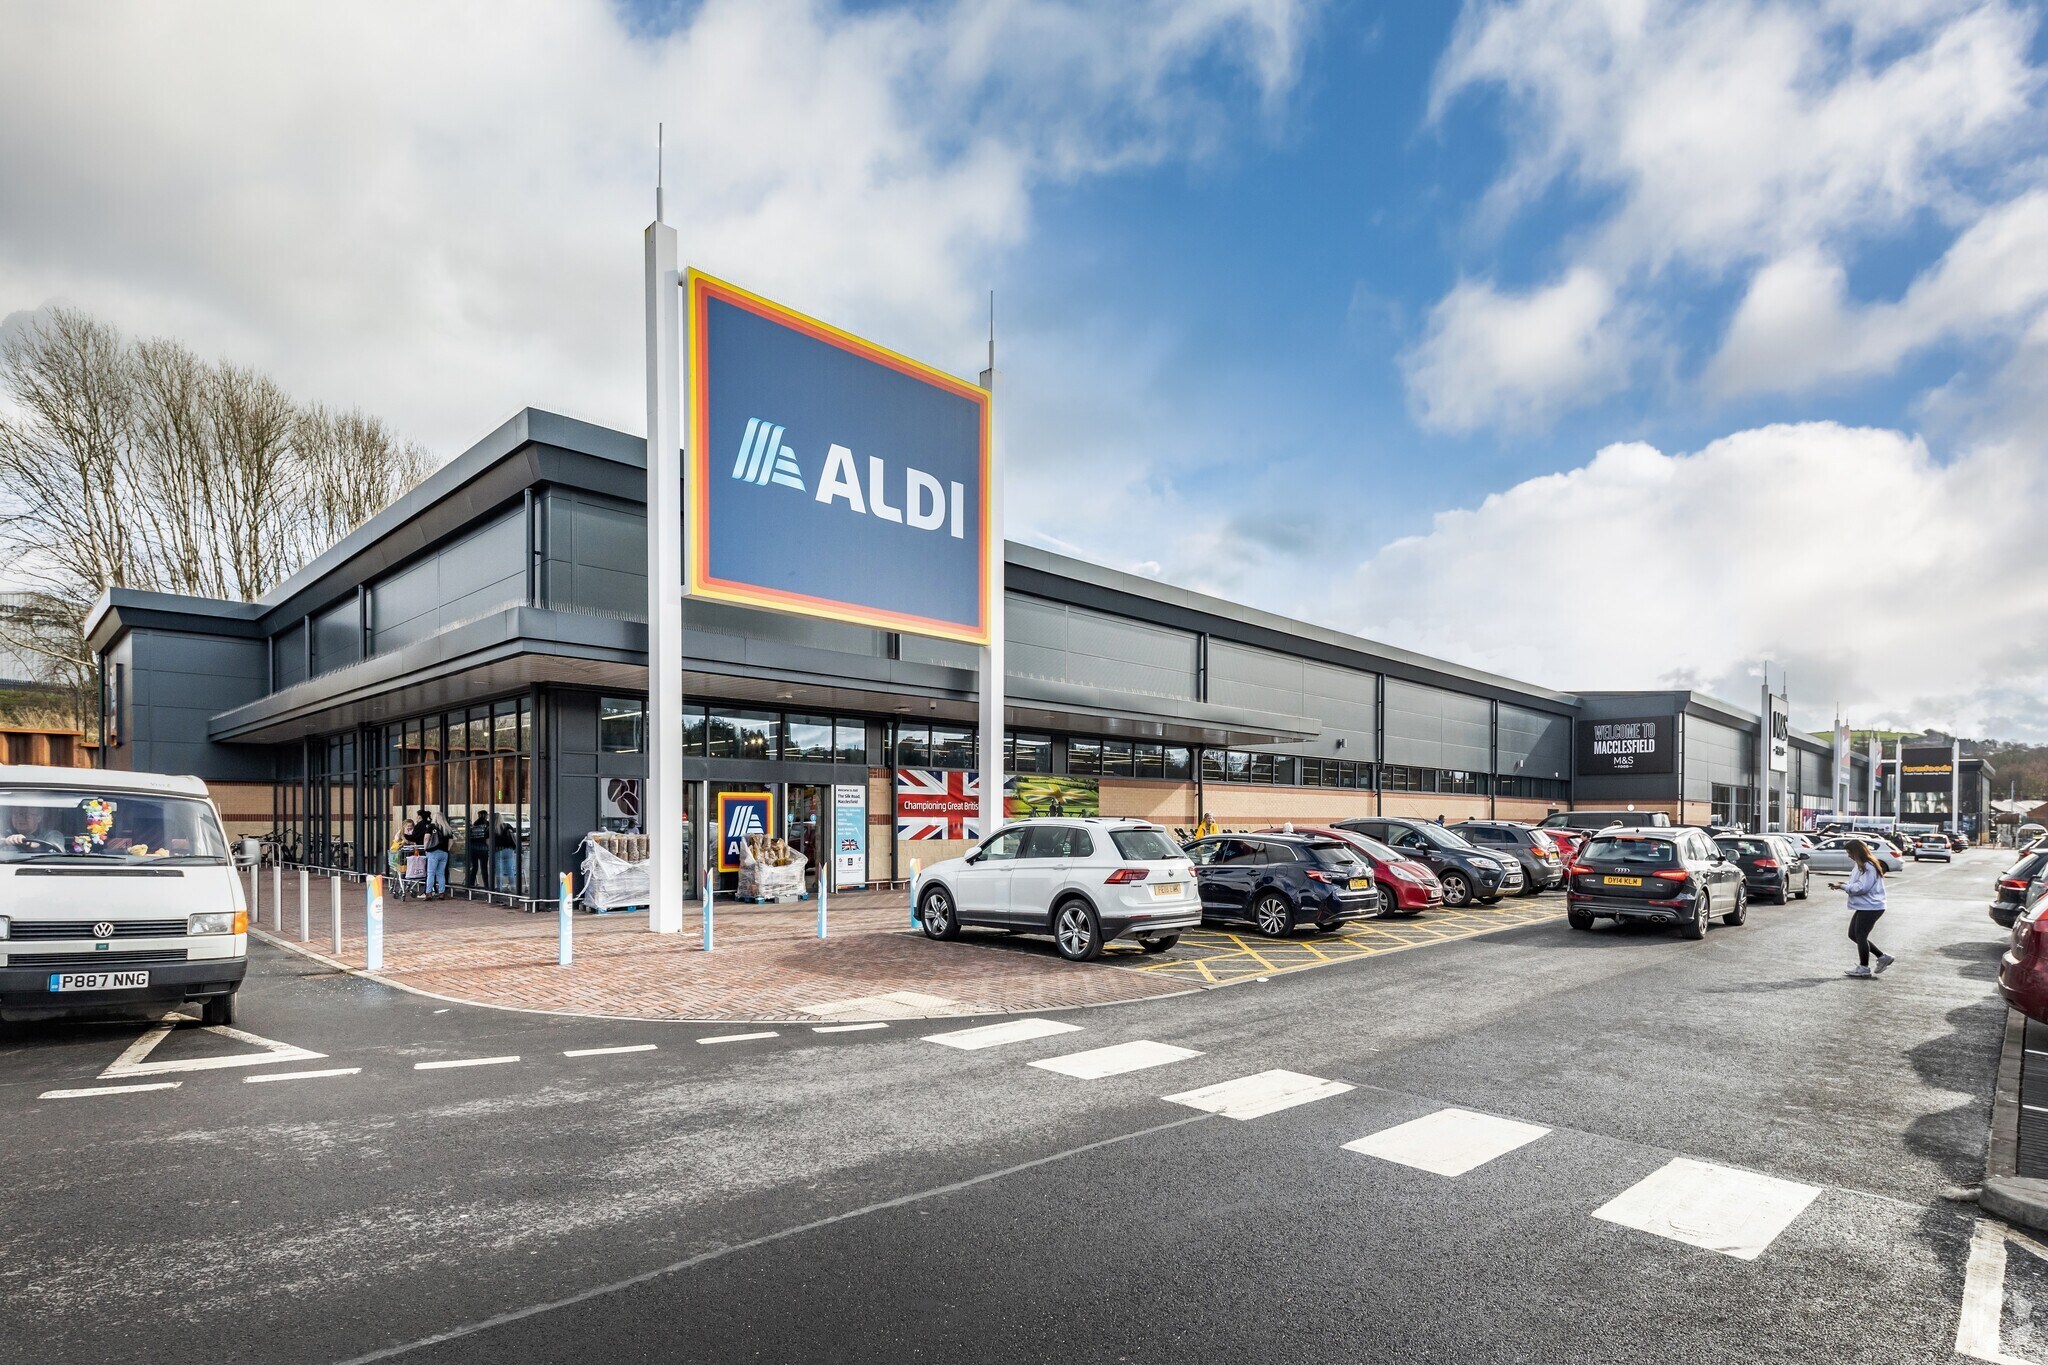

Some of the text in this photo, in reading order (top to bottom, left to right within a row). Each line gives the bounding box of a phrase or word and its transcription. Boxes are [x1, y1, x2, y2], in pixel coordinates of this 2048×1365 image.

[815, 443, 964, 539] ALDI
[1594, 722, 1655, 740] WELCOME TO
[1594, 739, 1655, 754] MACCLESFIELD
[1613, 756, 1634, 764] M&S
[904, 801, 979, 811] Championing Great Britis
[62, 973, 146, 988] P887 NNG
